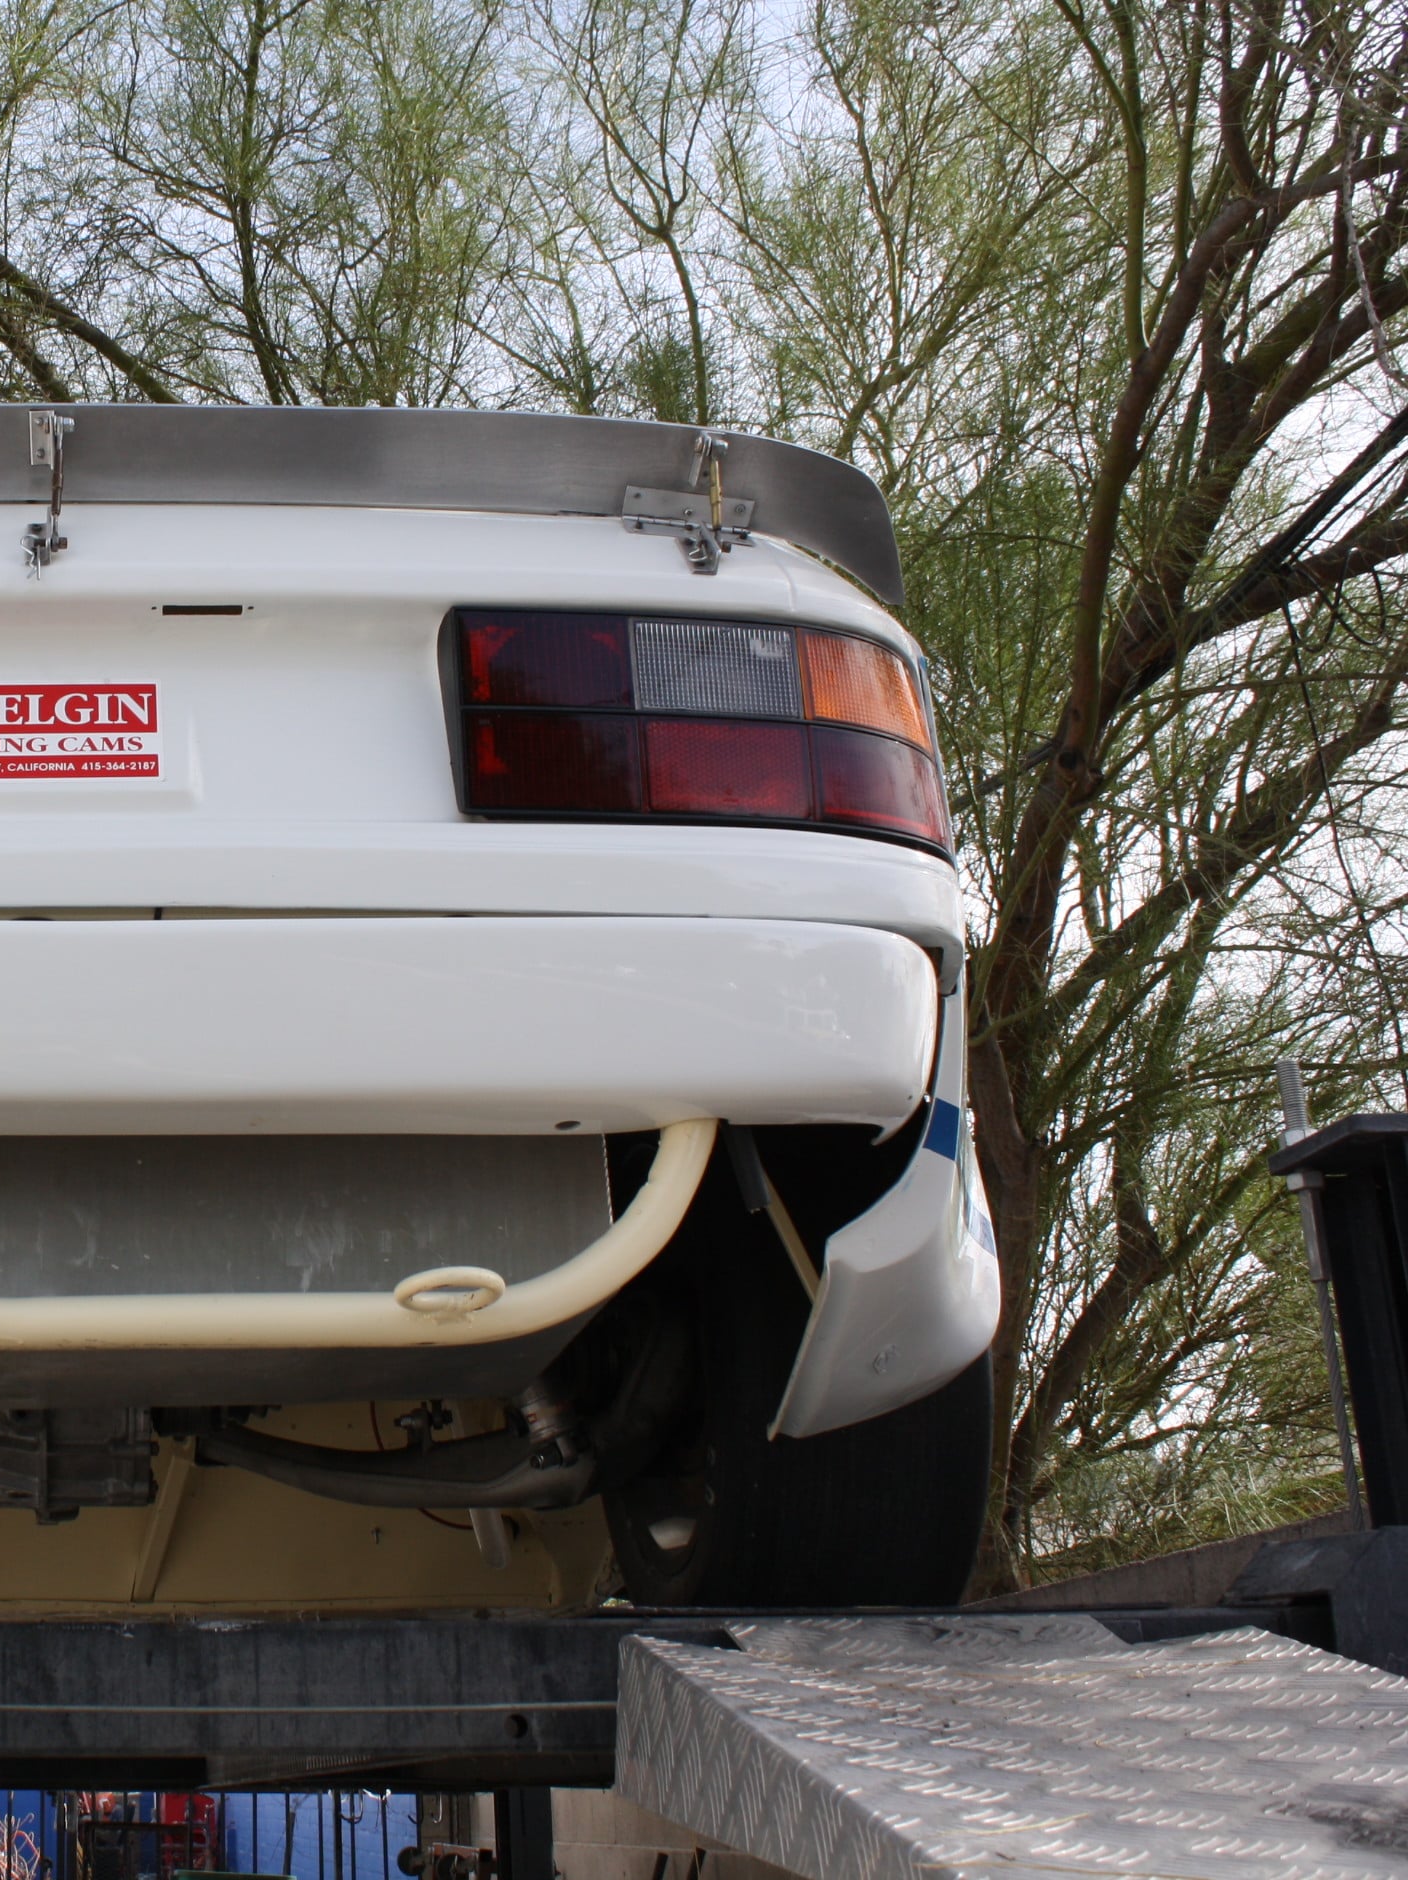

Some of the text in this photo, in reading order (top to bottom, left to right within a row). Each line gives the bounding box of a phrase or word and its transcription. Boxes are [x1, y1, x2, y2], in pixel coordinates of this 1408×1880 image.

[57, 735, 144, 753] CAMS
[7, 761, 76, 772] CALIFORNIA
[80, 761, 156, 771] 415-364-2187
